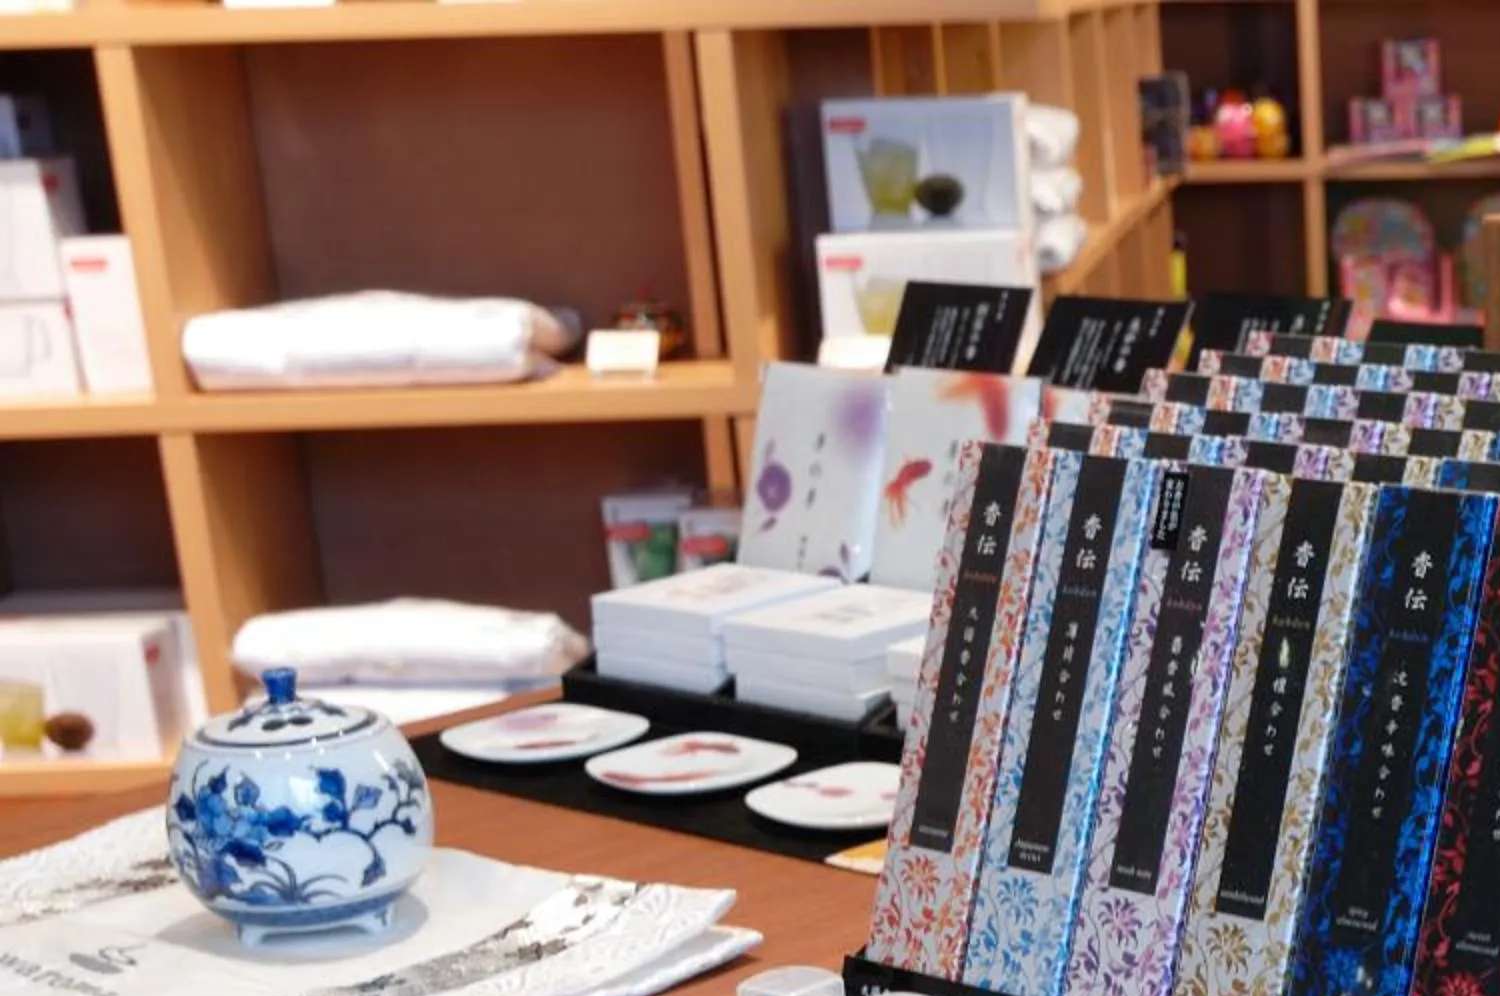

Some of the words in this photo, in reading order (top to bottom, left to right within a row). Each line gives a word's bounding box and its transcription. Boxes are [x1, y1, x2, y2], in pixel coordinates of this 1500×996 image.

[977, 500, 1002, 556] 香伝
[1075, 513, 1103, 570] 香伝
[1180, 524, 1208, 583] 香伝
[1286, 539, 1315, 600] 香伝
[1403, 550, 1433, 611] 香伝
